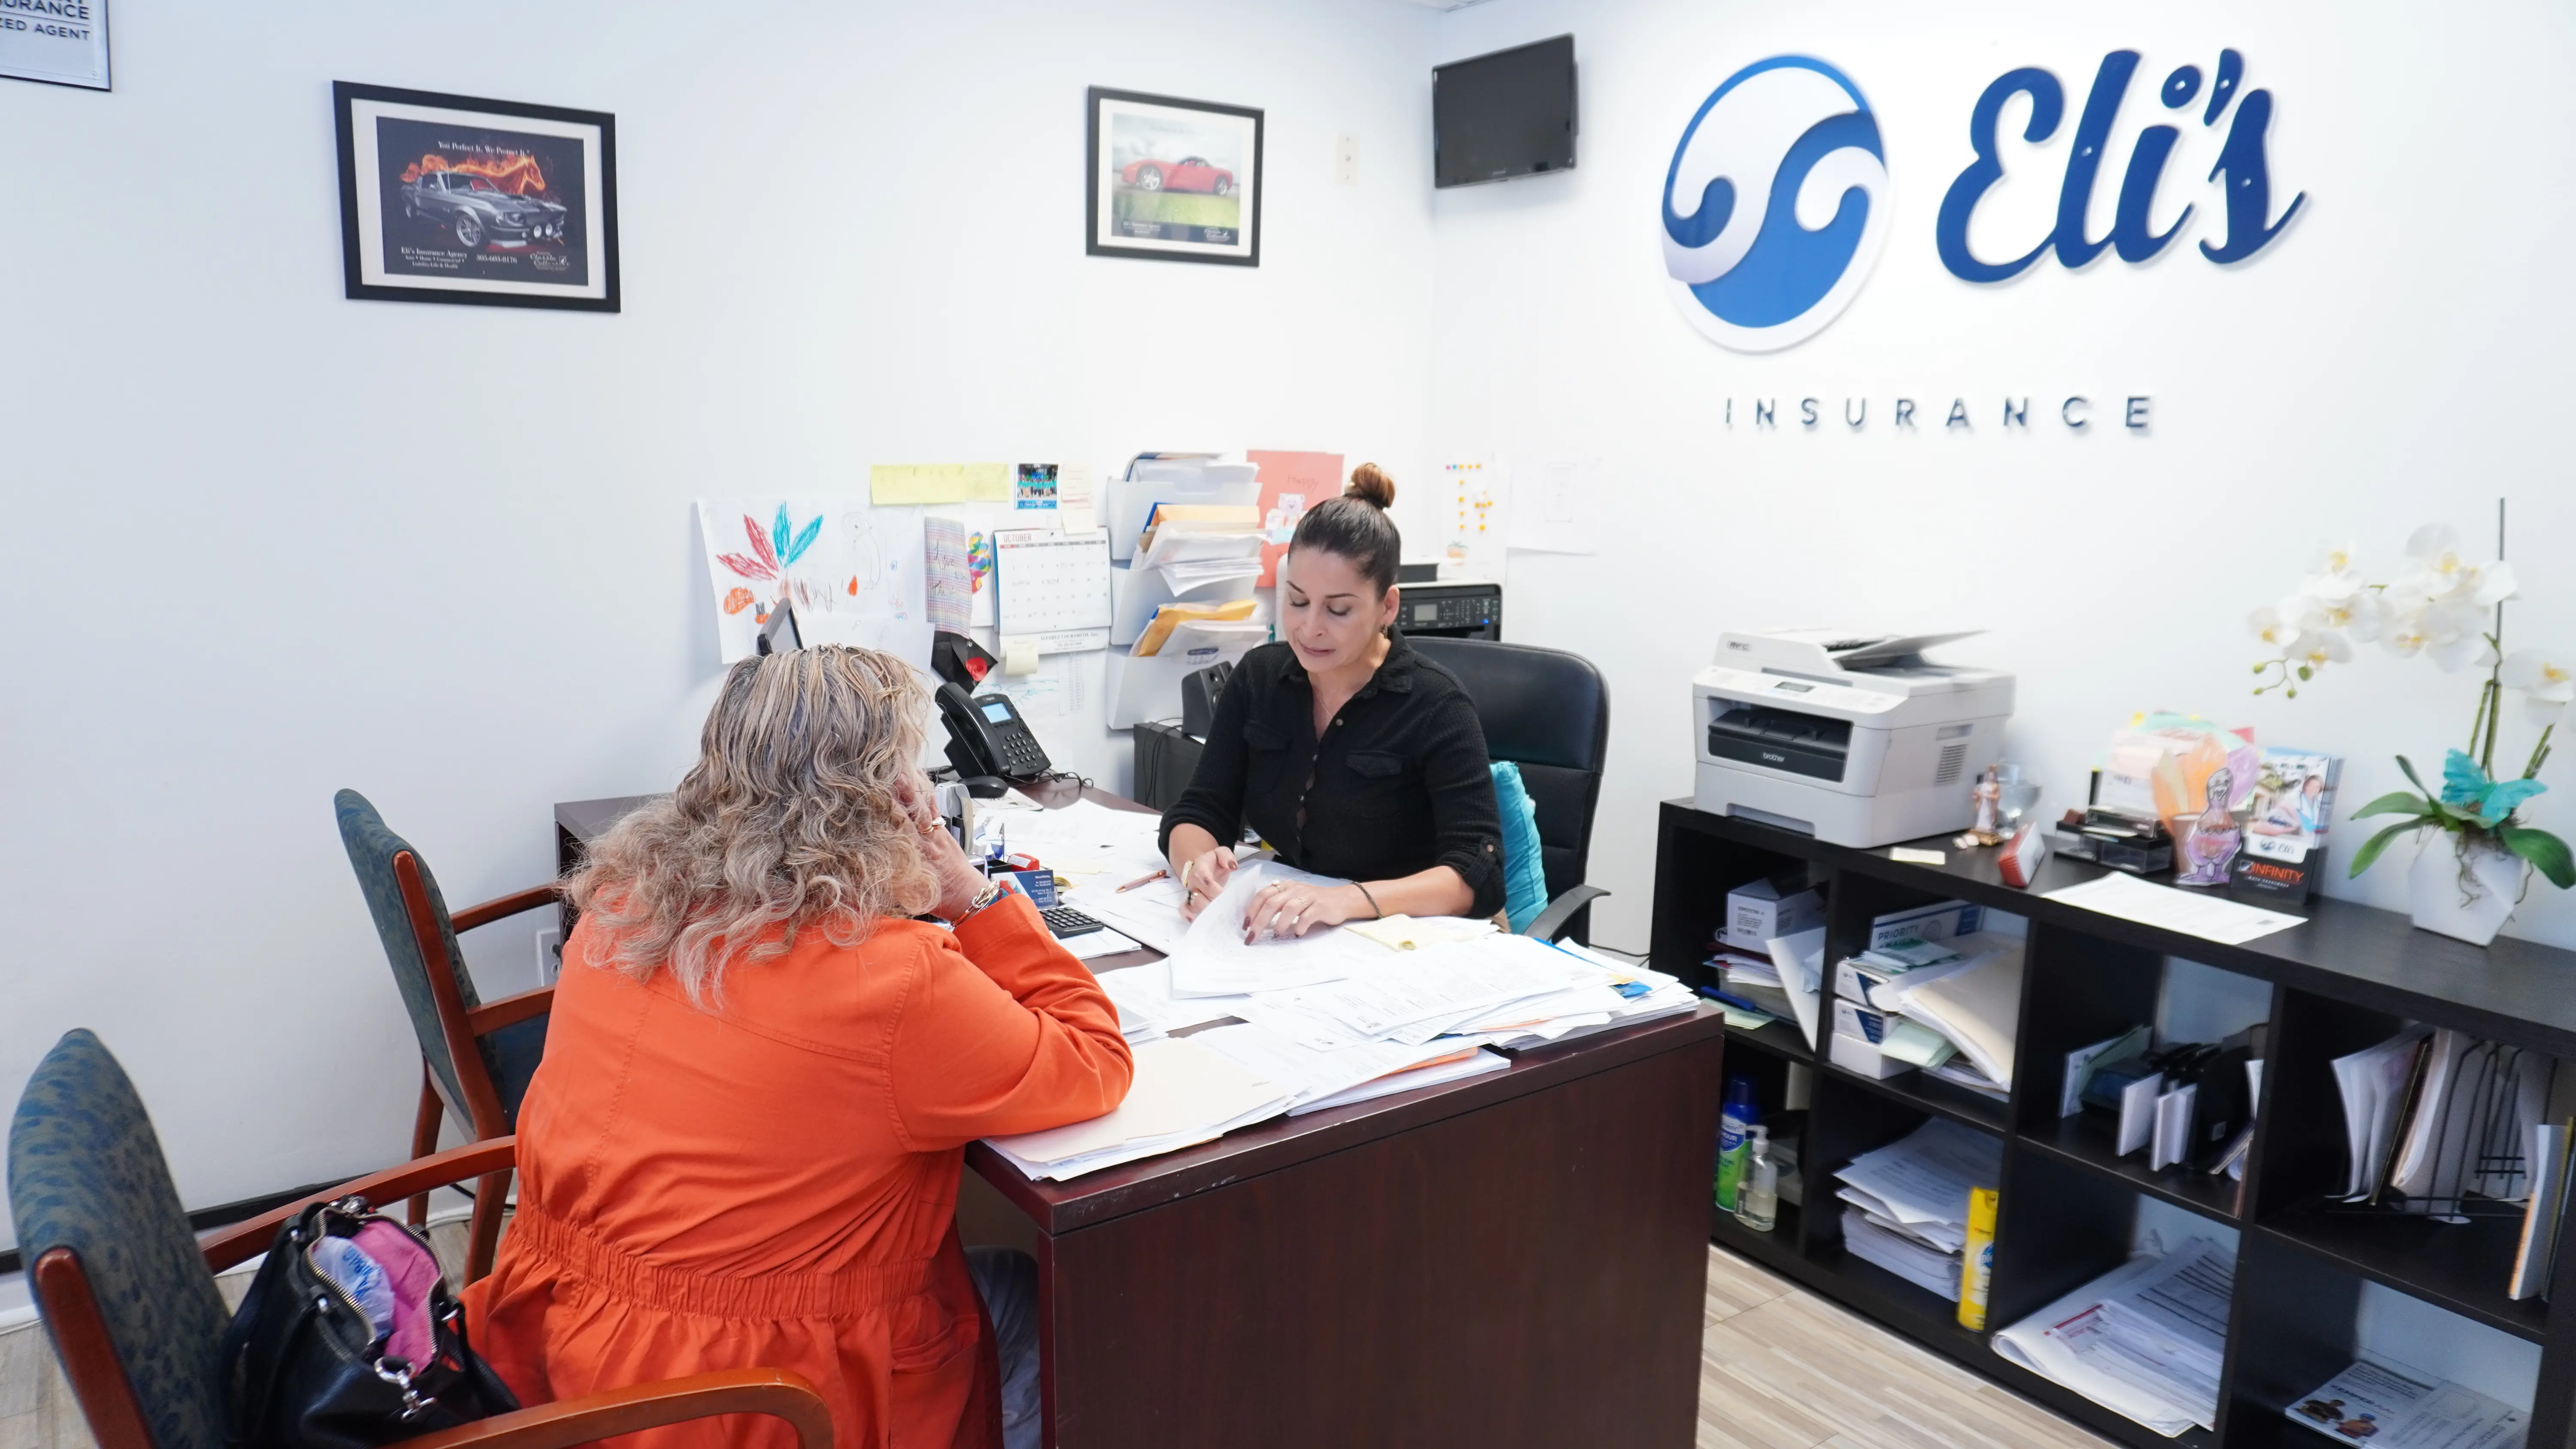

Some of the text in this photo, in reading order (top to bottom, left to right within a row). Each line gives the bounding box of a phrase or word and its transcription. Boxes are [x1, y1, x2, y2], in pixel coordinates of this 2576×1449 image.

[0, 0, 90, 19] URANCE
[33, 24, 90, 40] AGENT
[438, 140, 450, 149] You
[452, 142, 474, 152] Perfect
[485, 145, 495, 153] We
[496, 146, 518, 156] Protect
[1935, 48, 2308, 283] Eli's
[416, 247, 445, 256] Insurance
[447, 250, 468, 259] Agency
[1725, 395, 2152, 428] INSURANCE
[1288, 474, 1319, 494] Happy
[1003, 533, 1032, 543] OCTOBER
[1730, 642, 1749, 650] MFC
[1763, 752, 1785, 762] brother
[2251, 862, 2305, 882] INFINITY
[1878, 925, 1920, 941] PRIORITY
